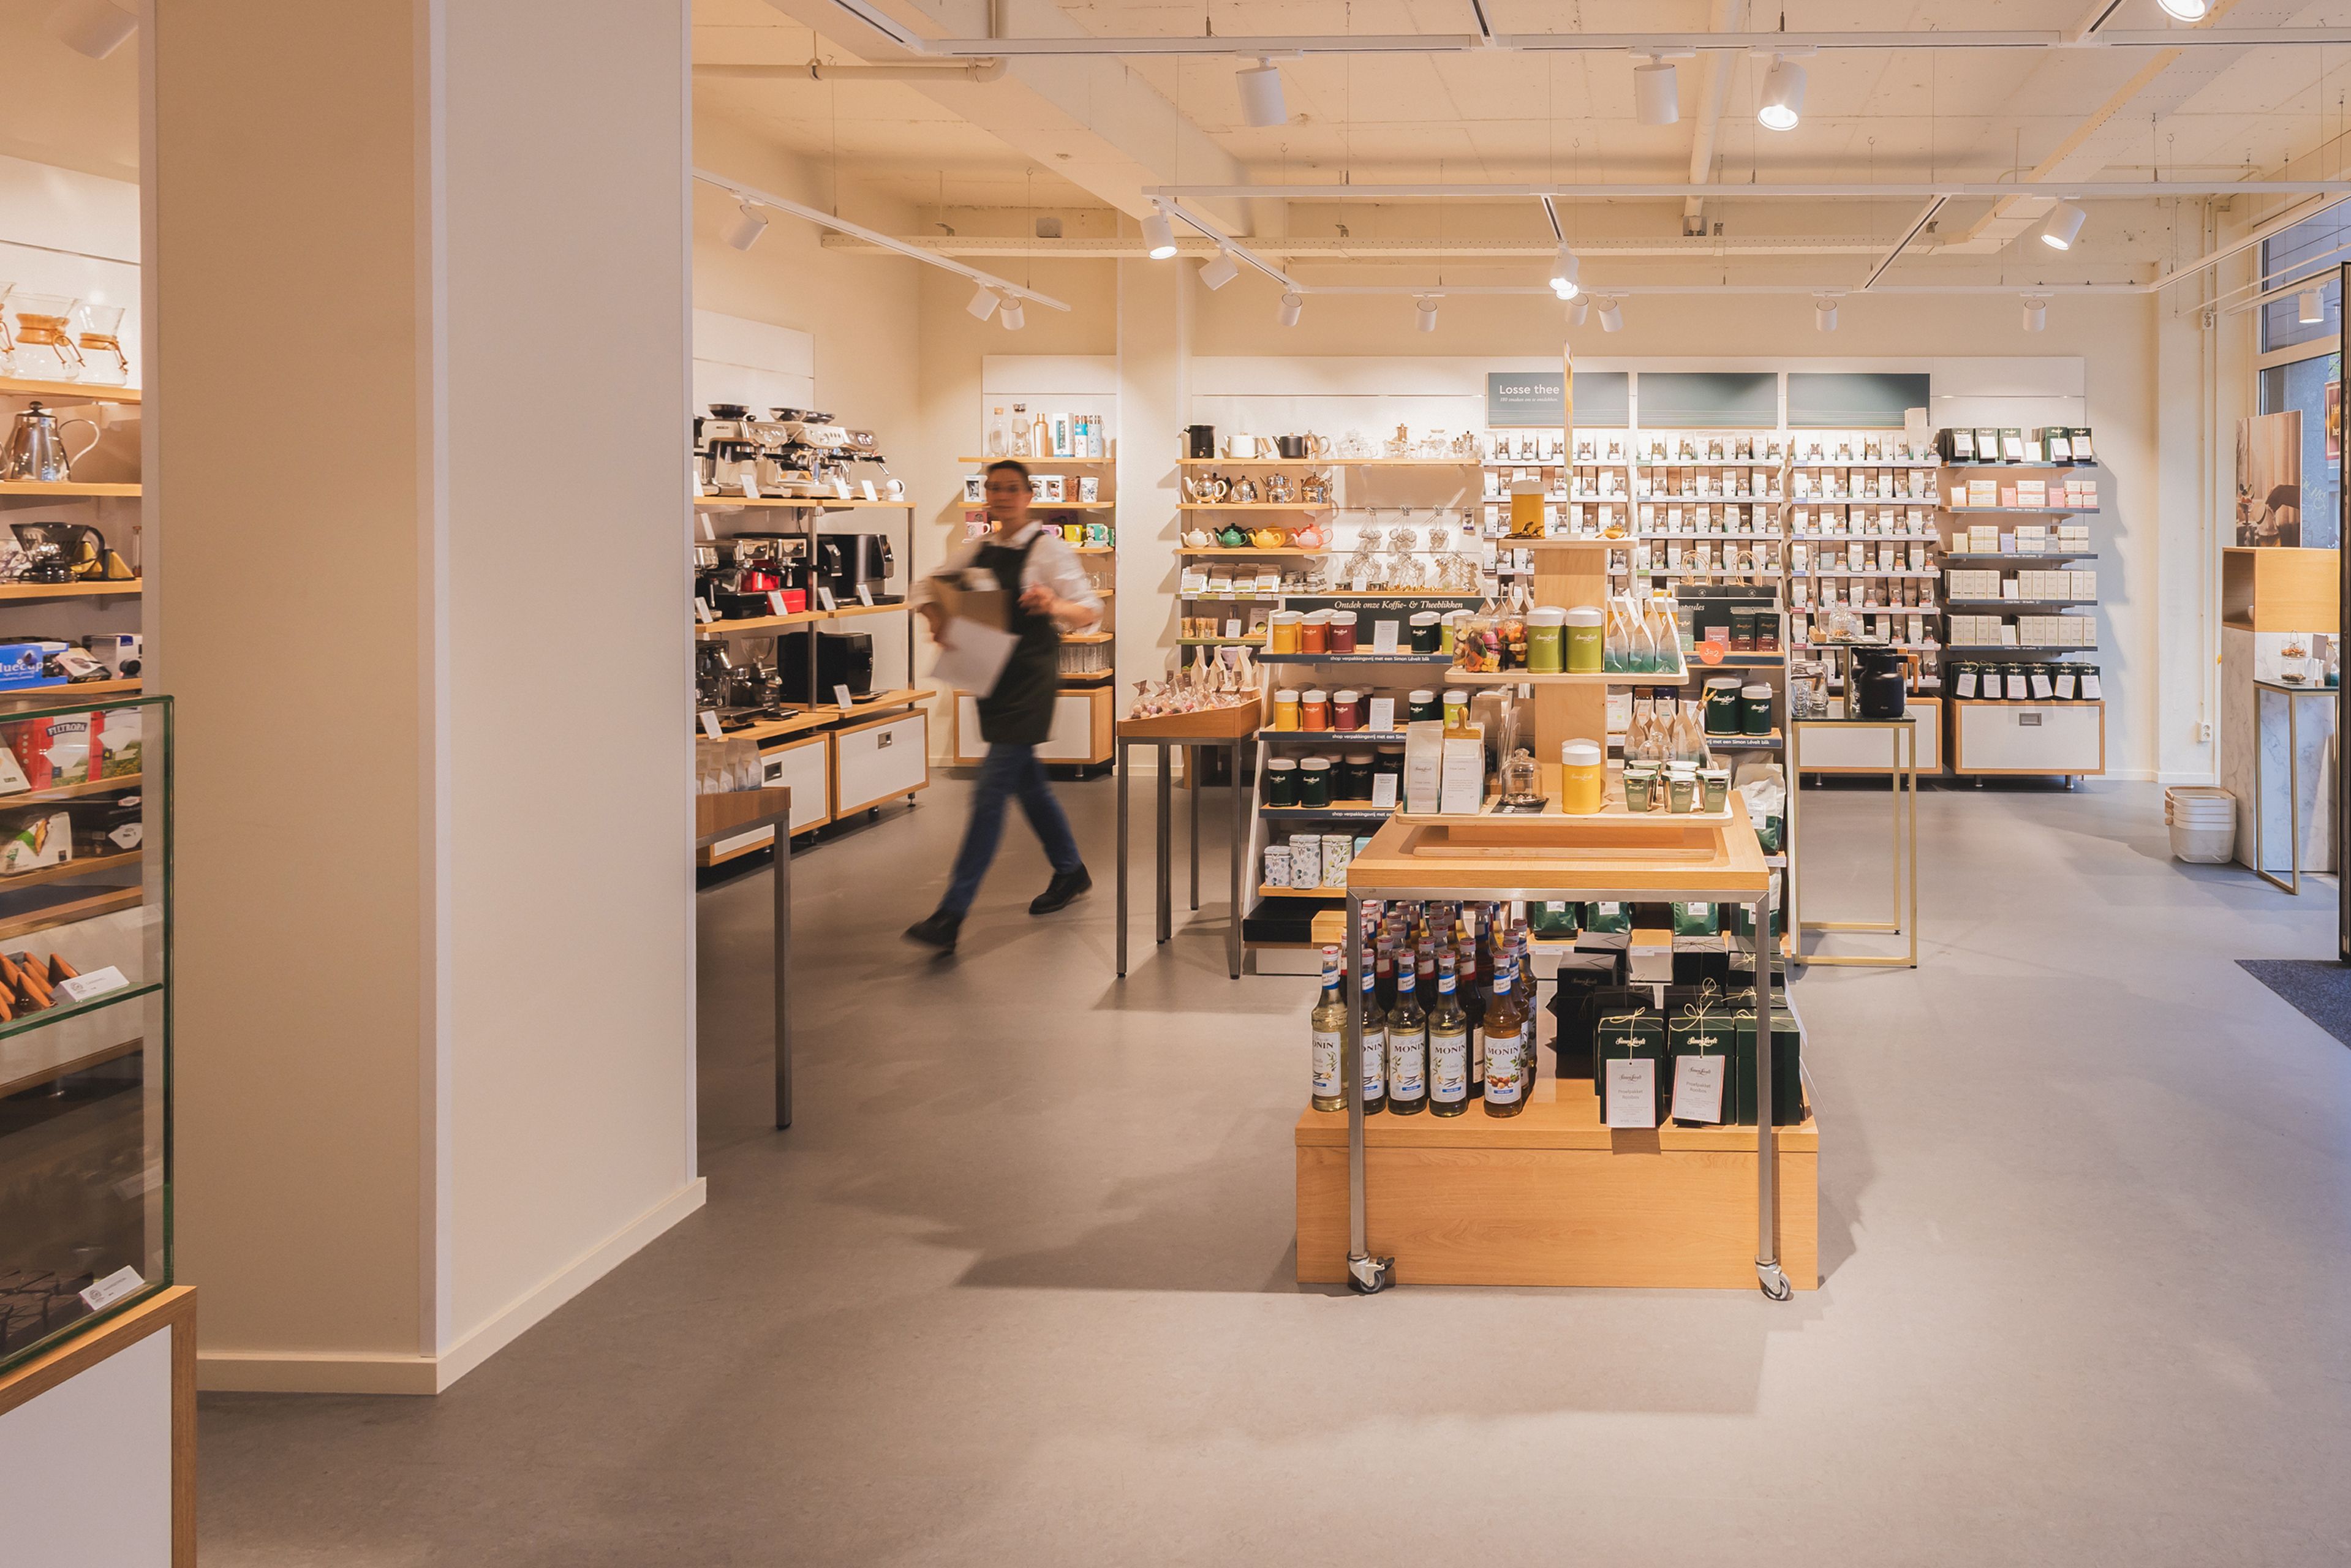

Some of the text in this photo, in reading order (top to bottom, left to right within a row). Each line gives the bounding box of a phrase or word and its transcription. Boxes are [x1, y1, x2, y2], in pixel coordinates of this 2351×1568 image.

[1500, 384, 1560, 394] Losse thee
[1381, 600, 1406, 611] Koffie-
[49, 723, 86, 735] FILTROPA
[1394, 1042, 1425, 1053] MONIN
[1435, 1044, 1465, 1054] MONIN
[1487, 1046, 1518, 1055] MONIN
